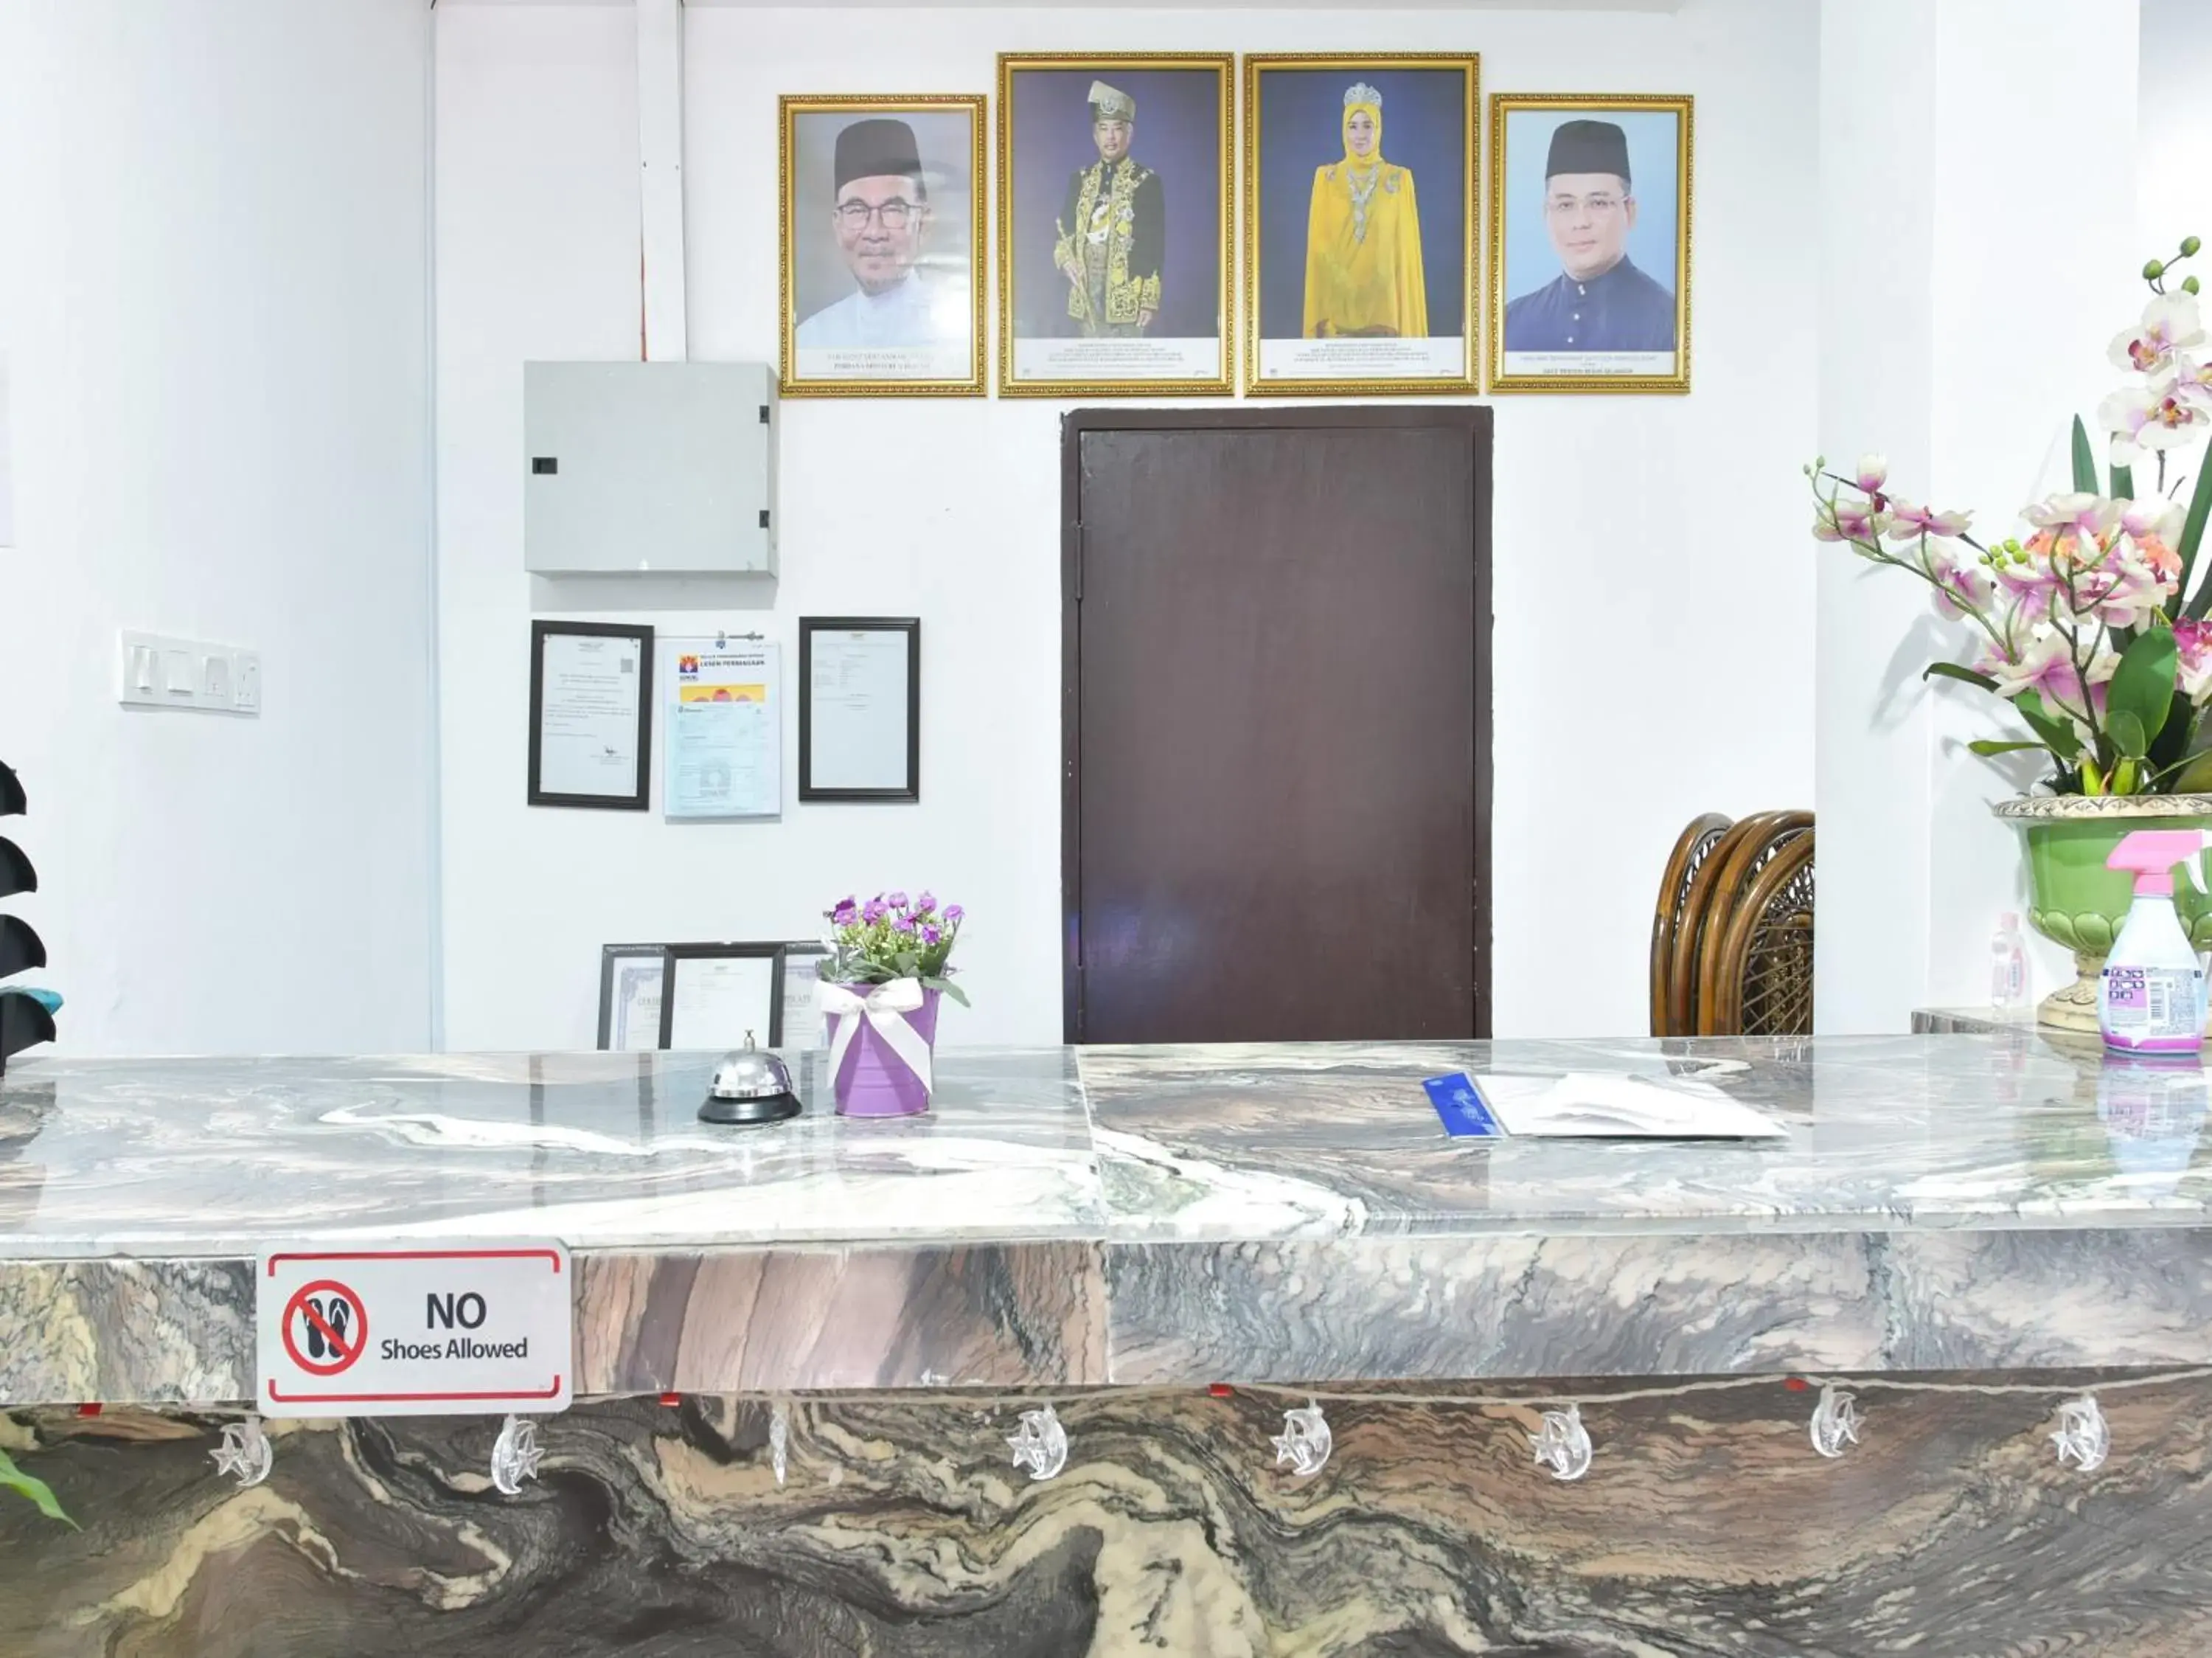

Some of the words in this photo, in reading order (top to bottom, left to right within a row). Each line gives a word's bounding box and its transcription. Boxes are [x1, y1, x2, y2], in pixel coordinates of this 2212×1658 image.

[427, 1292, 487, 1329] NO
[381, 1338, 442, 1359] Shoes
[445, 1337, 527, 1359] Allowed
